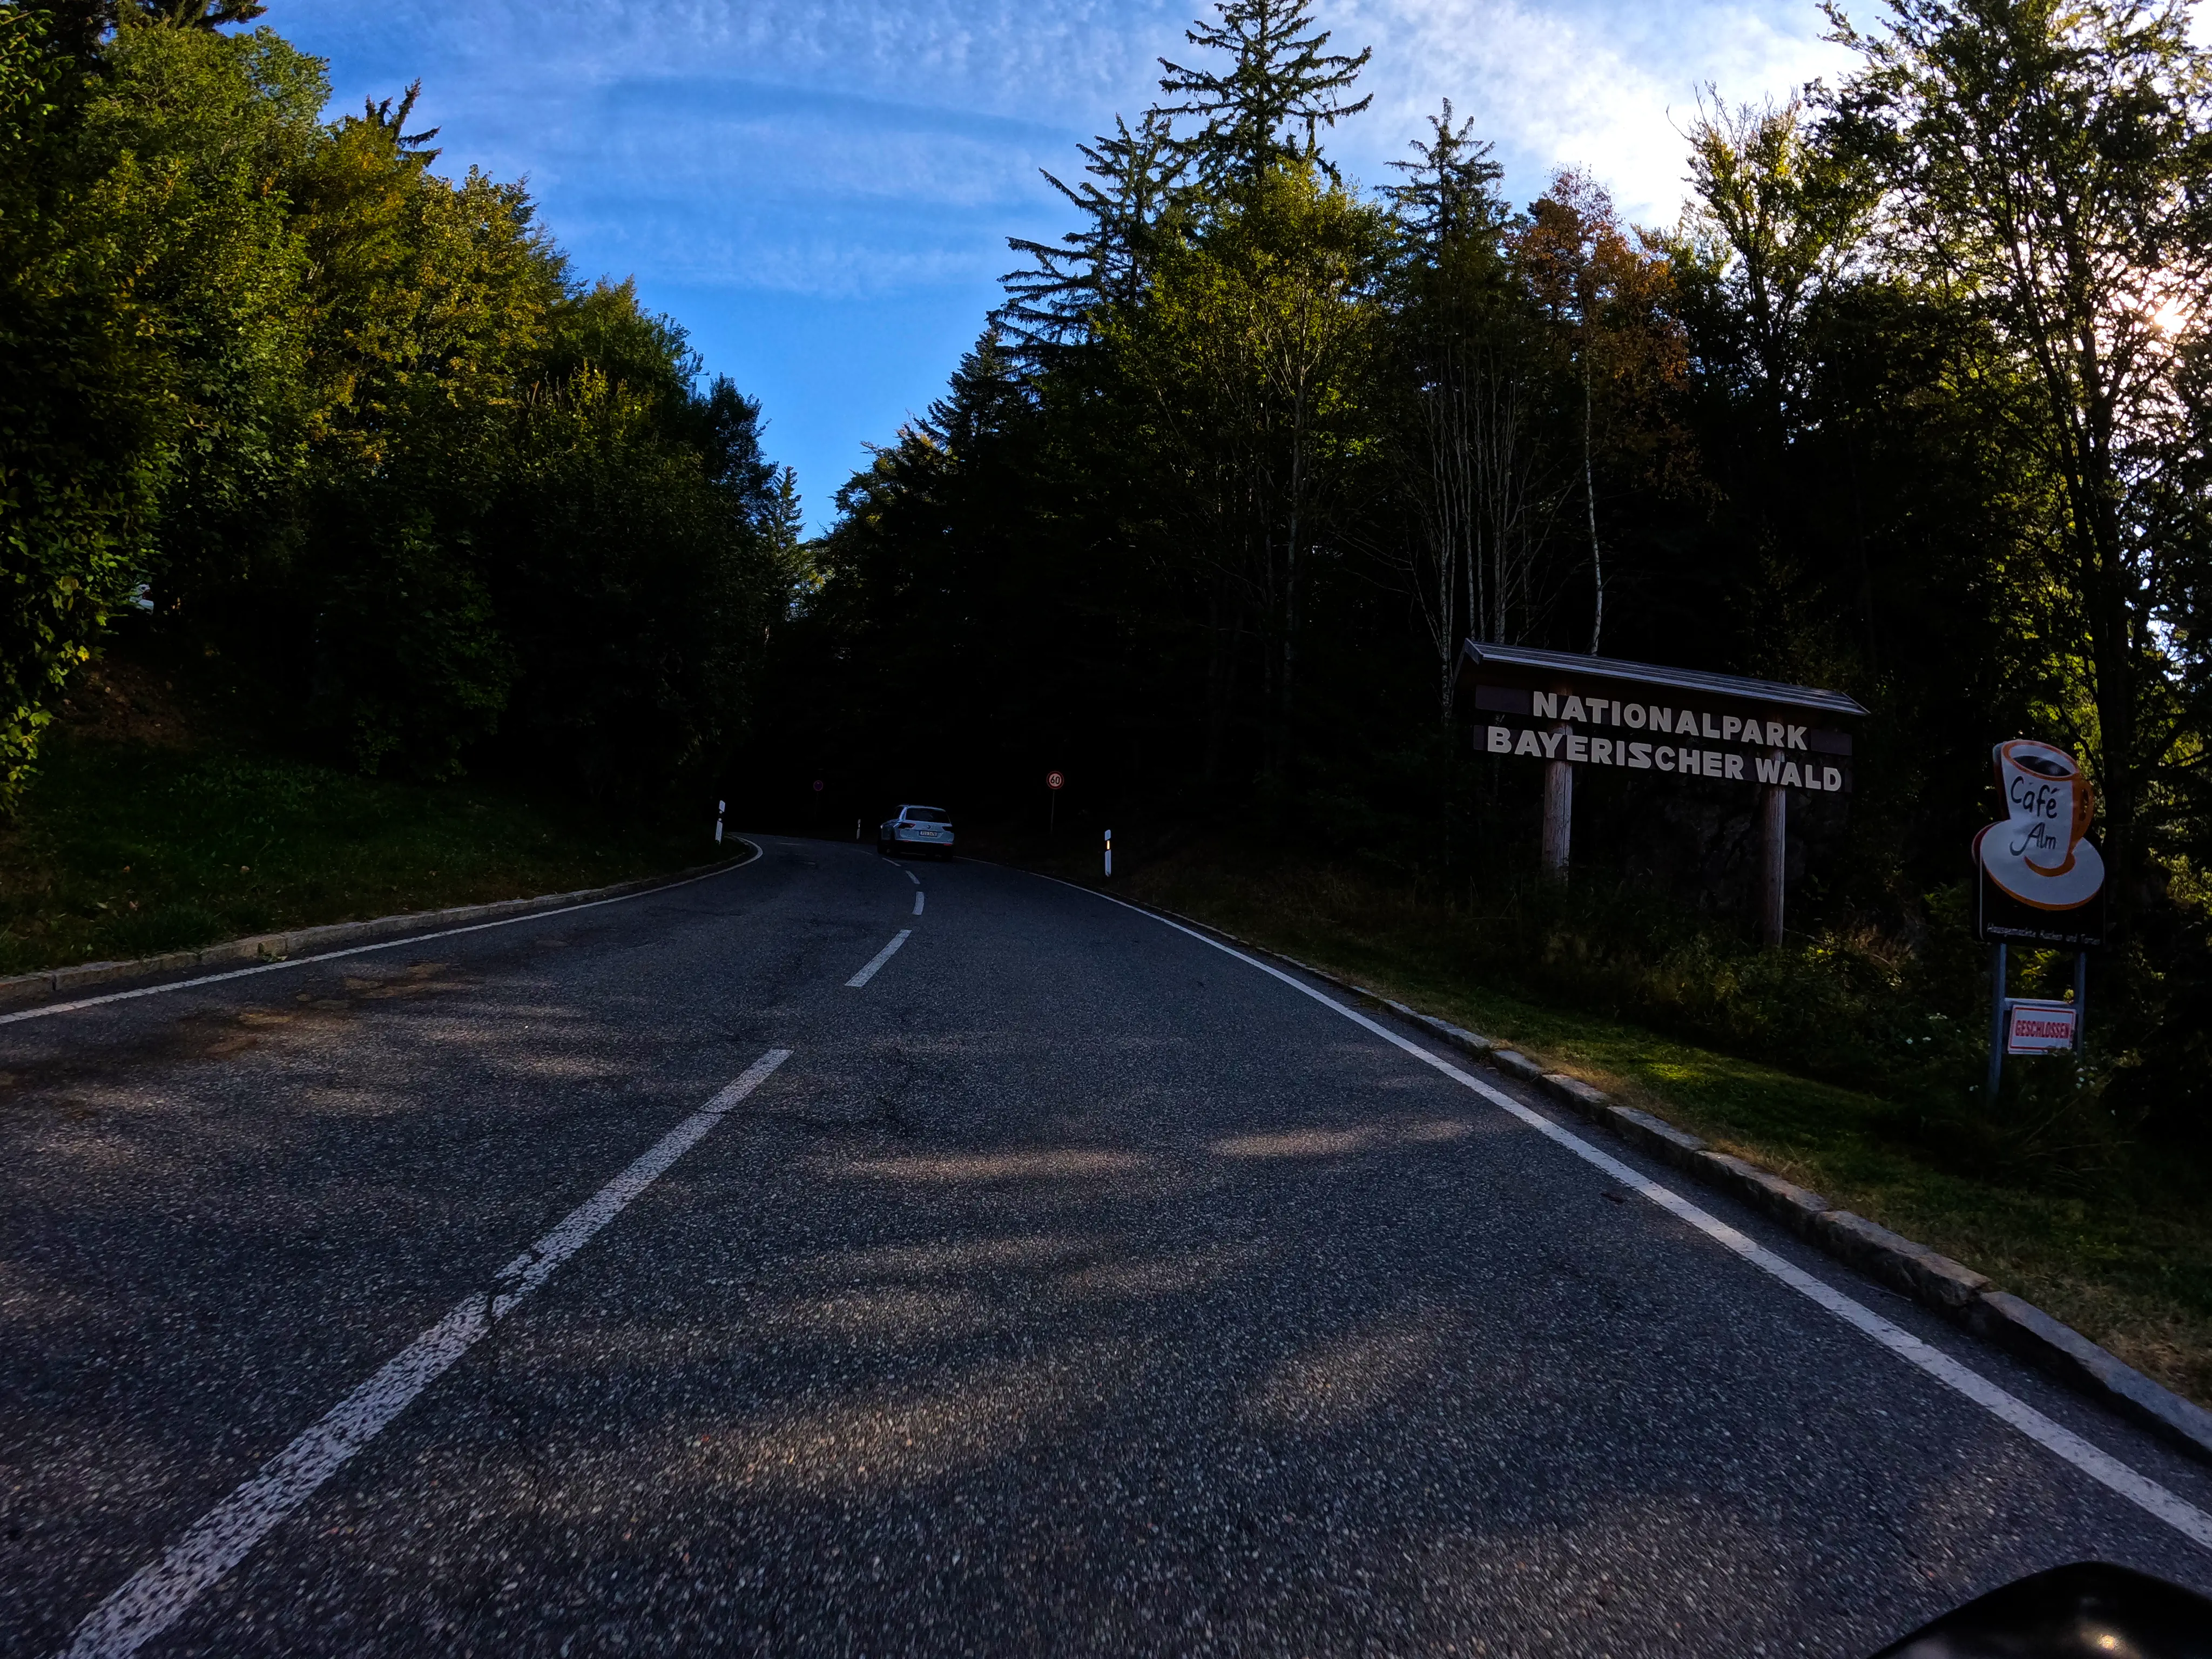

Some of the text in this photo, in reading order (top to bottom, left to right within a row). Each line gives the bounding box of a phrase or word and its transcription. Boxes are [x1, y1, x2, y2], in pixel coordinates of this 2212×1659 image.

[1533, 691, 1807, 750] NATIONALPARK
[1487, 725, 1842, 793] BAYERISCHER WALD
[1050, 775, 1060, 784] 60
[2011, 776, 2059, 818] Café
[2009, 822, 2056, 856] Alm
[2015, 1020, 2069, 1039] GESCHLOSSEN
